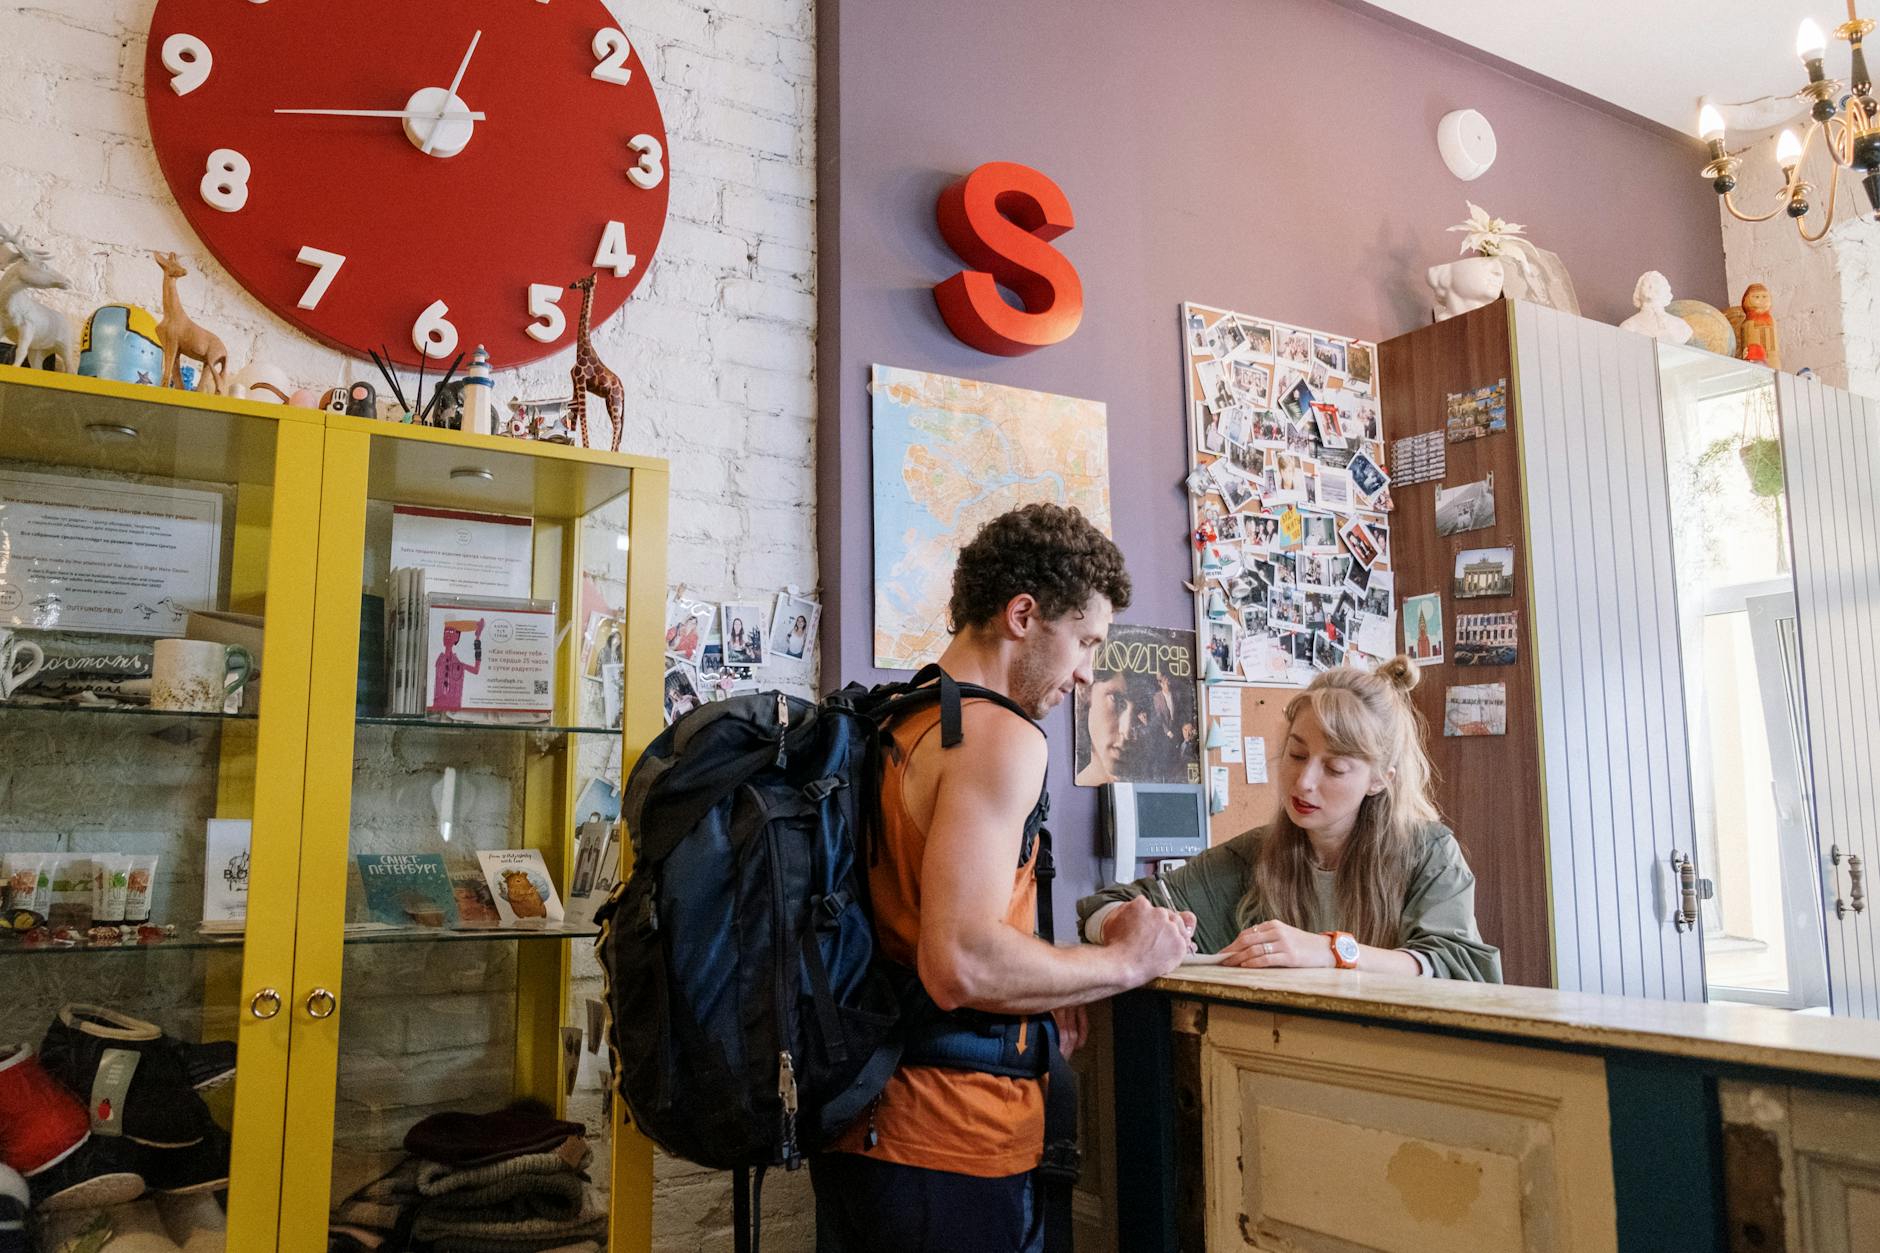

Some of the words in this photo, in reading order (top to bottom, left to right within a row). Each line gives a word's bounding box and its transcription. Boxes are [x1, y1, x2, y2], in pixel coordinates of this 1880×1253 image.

[160, 32, 213, 97] 9
[591, 27, 632, 86] 2
[200, 147, 252, 213] 8
[625, 132, 665, 191] 3
[296, 244, 347, 311] 7
[592, 219, 637, 279] 4
[933, 161, 1084, 358] S
[411, 298, 459, 361] 6
[524, 282, 567, 345] 5
[368, 863, 438, 875] ПЕТЕРБУРГ
